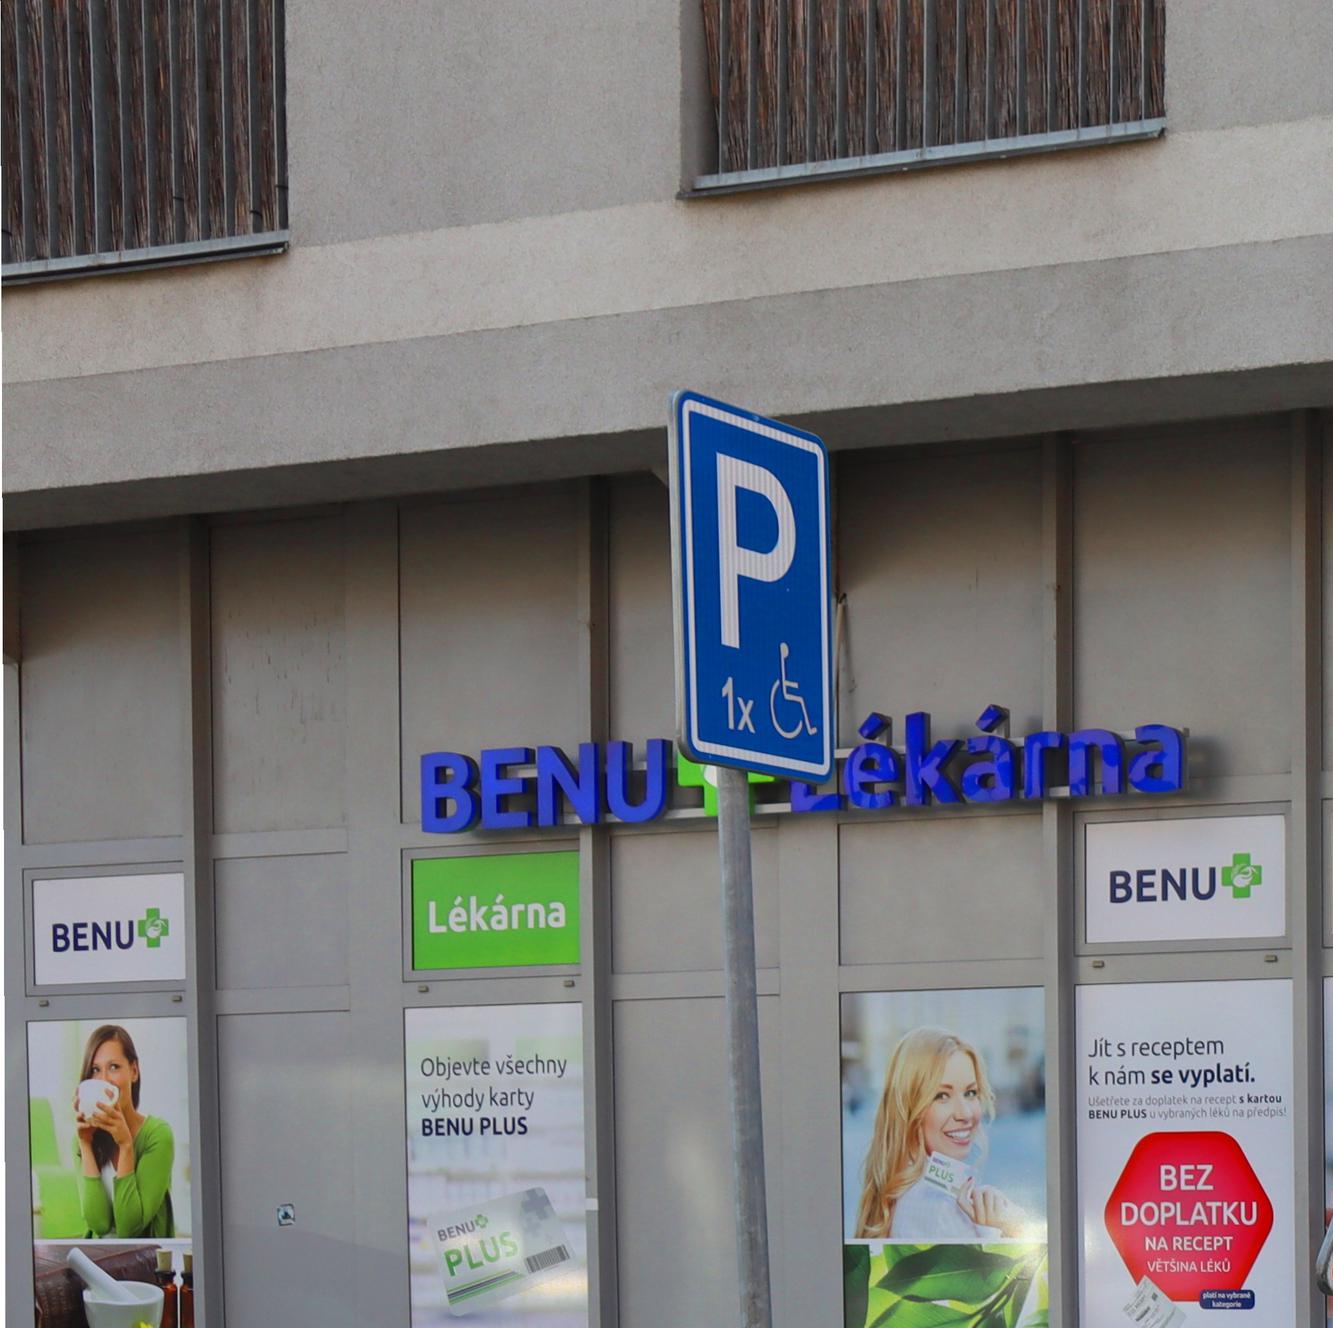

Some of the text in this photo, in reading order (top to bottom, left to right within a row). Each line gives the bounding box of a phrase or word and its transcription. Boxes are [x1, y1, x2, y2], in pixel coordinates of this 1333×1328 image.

[716, 452, 796, 649] P
[721, 676, 756, 733] 1x
[420, 738, 673, 834] BENU
[1108, 866, 1217, 904] BENU
[427, 893, 567, 934] Lékárna
[51, 920, 134, 953] BENU
[1088, 1037, 1224, 1060] Jít s receptem
[420, 1053, 567, 1081] Objevte všechny
[1089, 1062, 1255, 1088] k nám se vyplatí.
[421, 1086, 535, 1113] výhody karty
[1088, 1093, 1282, 1108] Ušetřete za doplatek na recept s kartou
[1088, 1109, 1117, 1119] BENU
[1120, 1109, 1147, 1119] PLUS
[1150, 1111, 1156, 1119] u
[1158, 1105, 1207, 1121] vybraných
[1209, 1106, 1230, 1118] léků
[1232, 1107, 1244, 1117] na
[421, 1116, 528, 1137] BENU PLUS
[1160, 1164, 1214, 1191] BEZ
[1120, 1201, 1258, 1226] DOPLATKU
[437, 1221, 476, 1242] BENU
[1144, 1236, 1233, 1251] NA RECEPT
[444, 1231, 519, 1277] PLUS
[1147, 1258, 1231, 1273] VĚTŠINA LÉKŮ
[1212, 1300, 1242, 1309] kategorie
